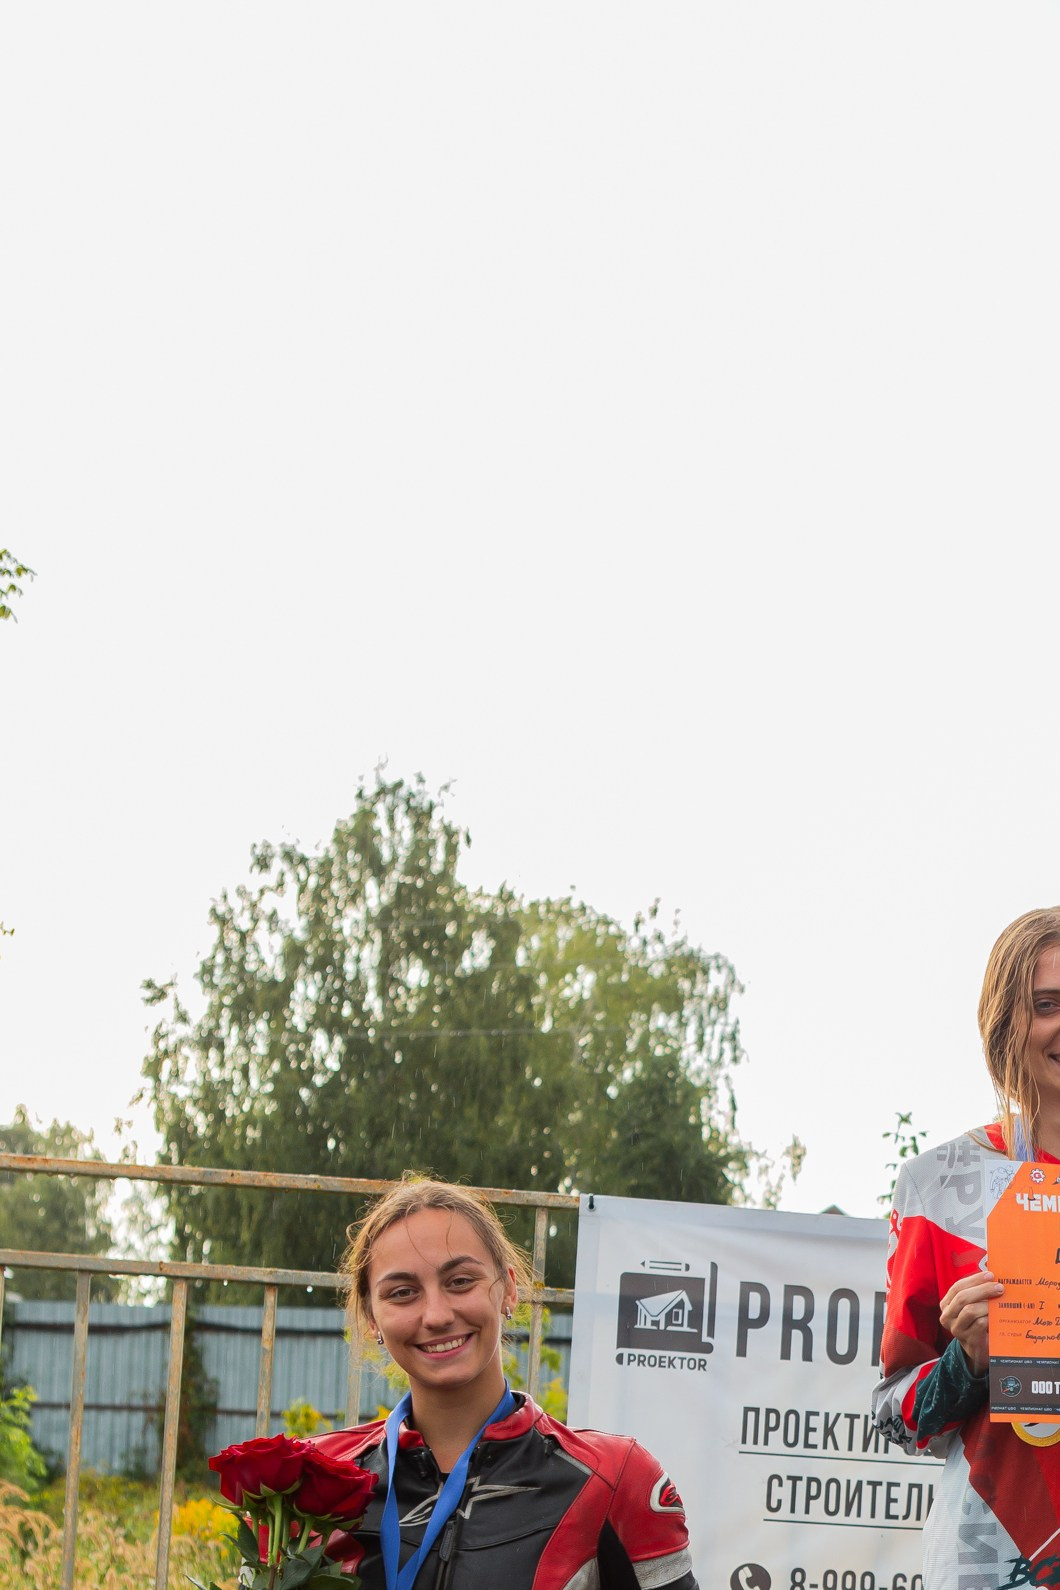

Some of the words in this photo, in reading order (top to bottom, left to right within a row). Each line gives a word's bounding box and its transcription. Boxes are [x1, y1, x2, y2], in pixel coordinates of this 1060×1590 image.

[737, 1281, 887, 1366] PRO
[627, 1354, 707, 1371] PROEKTOR
[1031, 1381, 1052, 1394] ООО
[741, 1406, 890, 1454] ПРОЕКТИ
